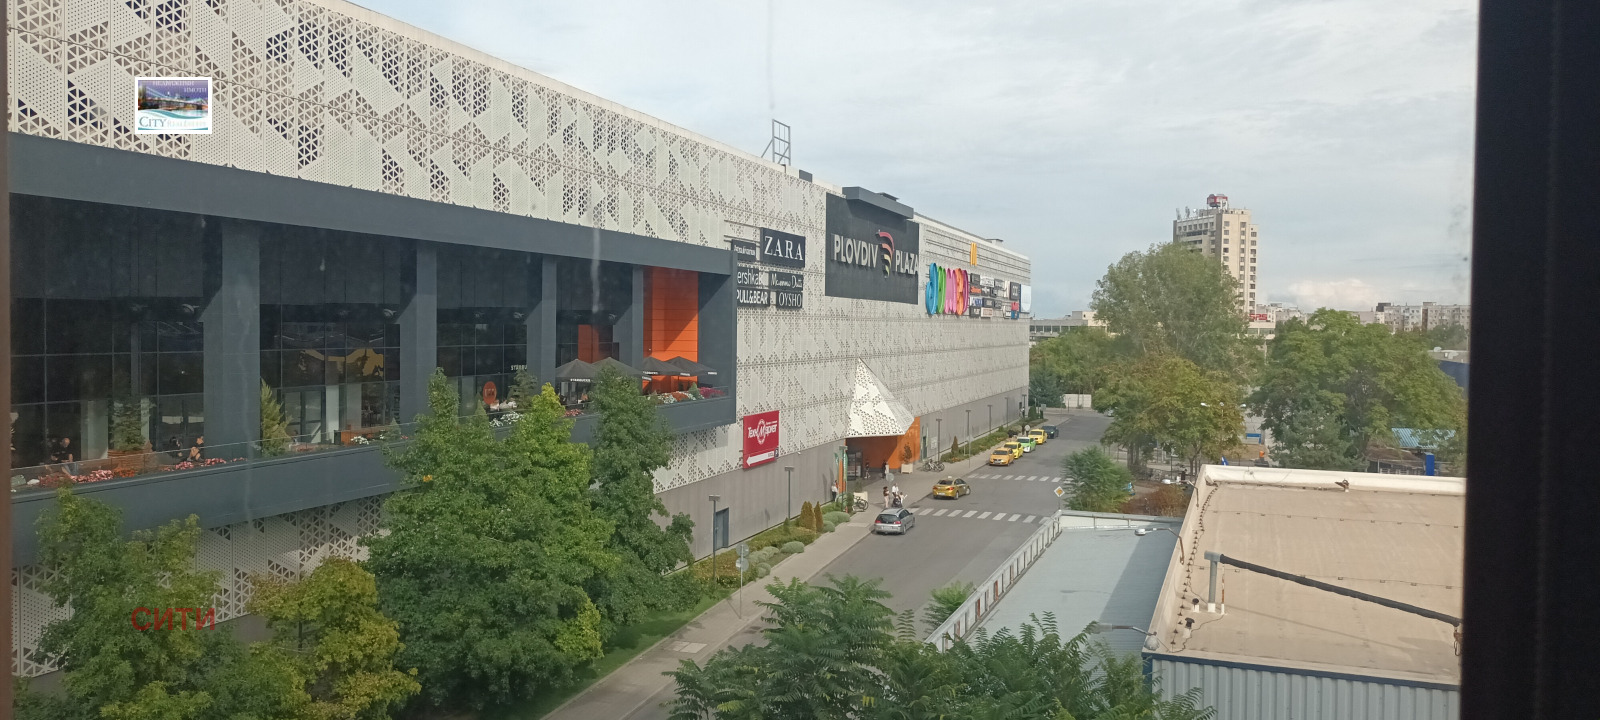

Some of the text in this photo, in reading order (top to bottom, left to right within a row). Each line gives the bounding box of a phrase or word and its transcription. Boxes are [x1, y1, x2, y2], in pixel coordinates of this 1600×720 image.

[764, 235, 804, 261] ZARA
[833, 234, 920, 275] PLOVDIV PLAZA
[737, 269, 759, 285] ershka
[778, 292, 802, 307] OYSHO
